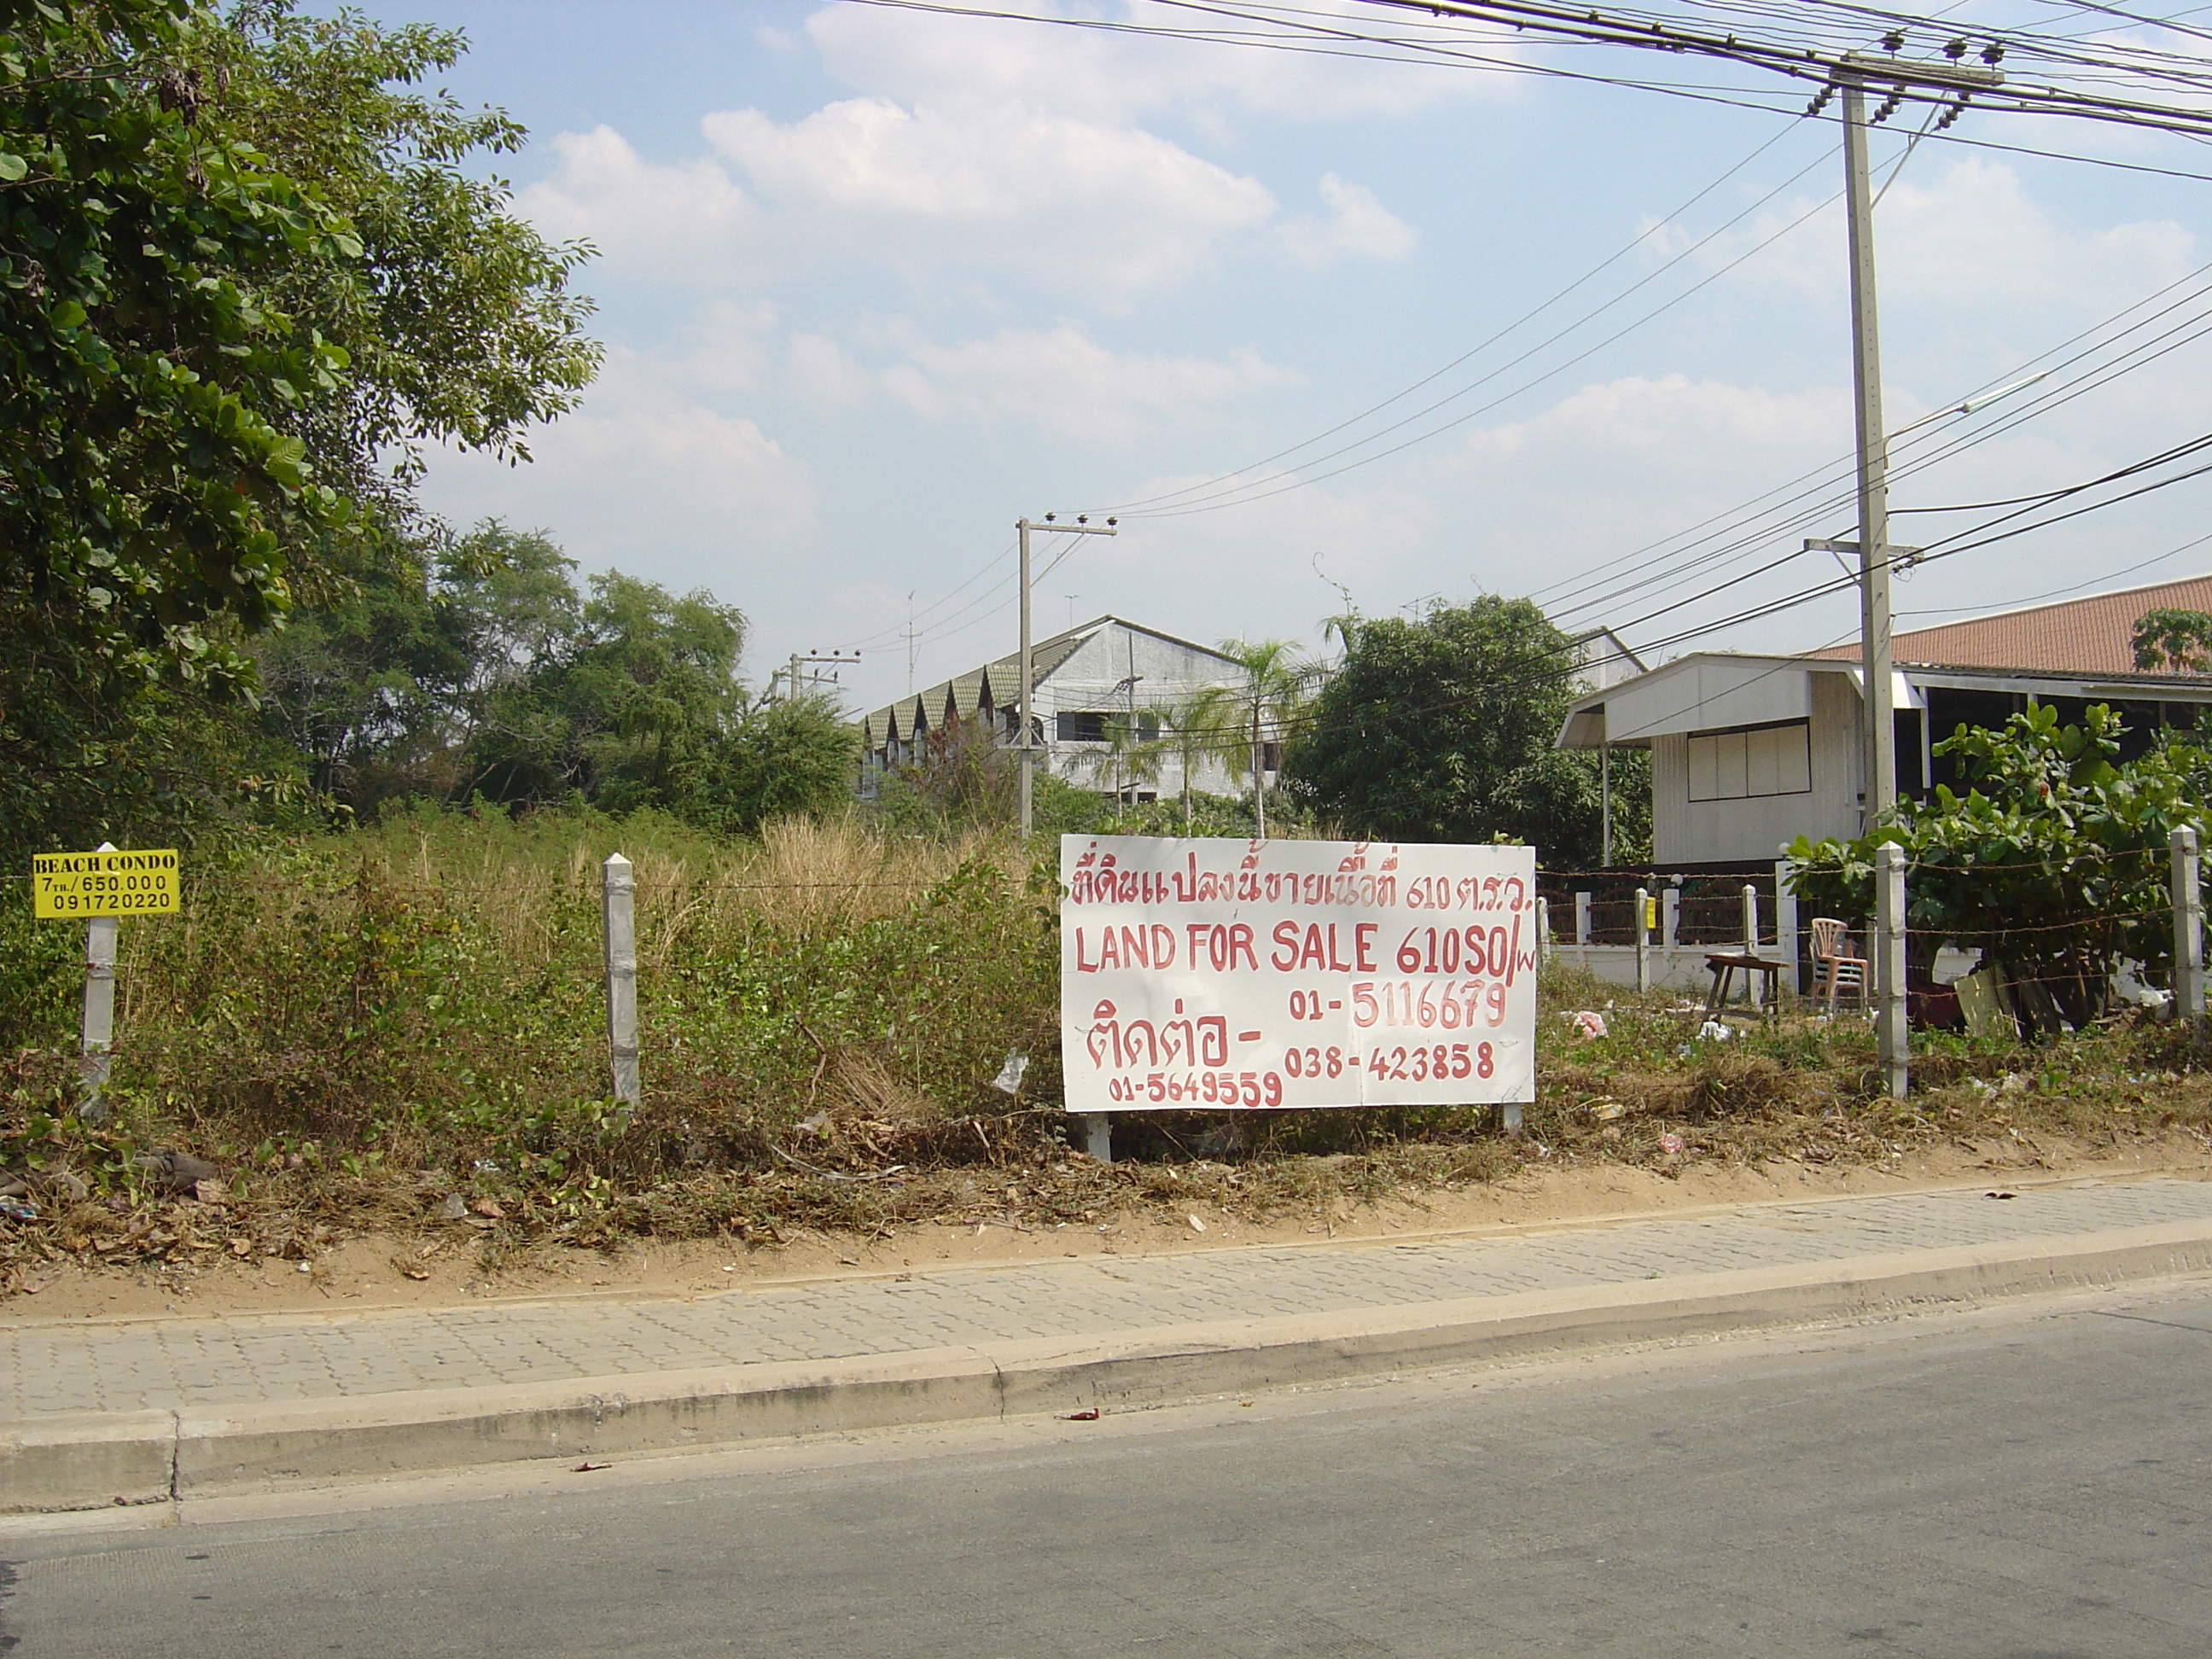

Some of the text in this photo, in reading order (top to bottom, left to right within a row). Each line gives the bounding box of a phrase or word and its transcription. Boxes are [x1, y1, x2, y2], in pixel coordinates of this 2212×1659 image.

[34, 854, 176, 874] BEACH CONDO
[54, 894, 170, 910] 091720220
[1406, 876, 1451, 910] 610
[1075, 923, 1176, 973] LAND
[1185, 923, 1260, 972] FOR
[1271, 920, 1379, 972] SALE
[1109, 1072, 1283, 1108] 01-5649559
